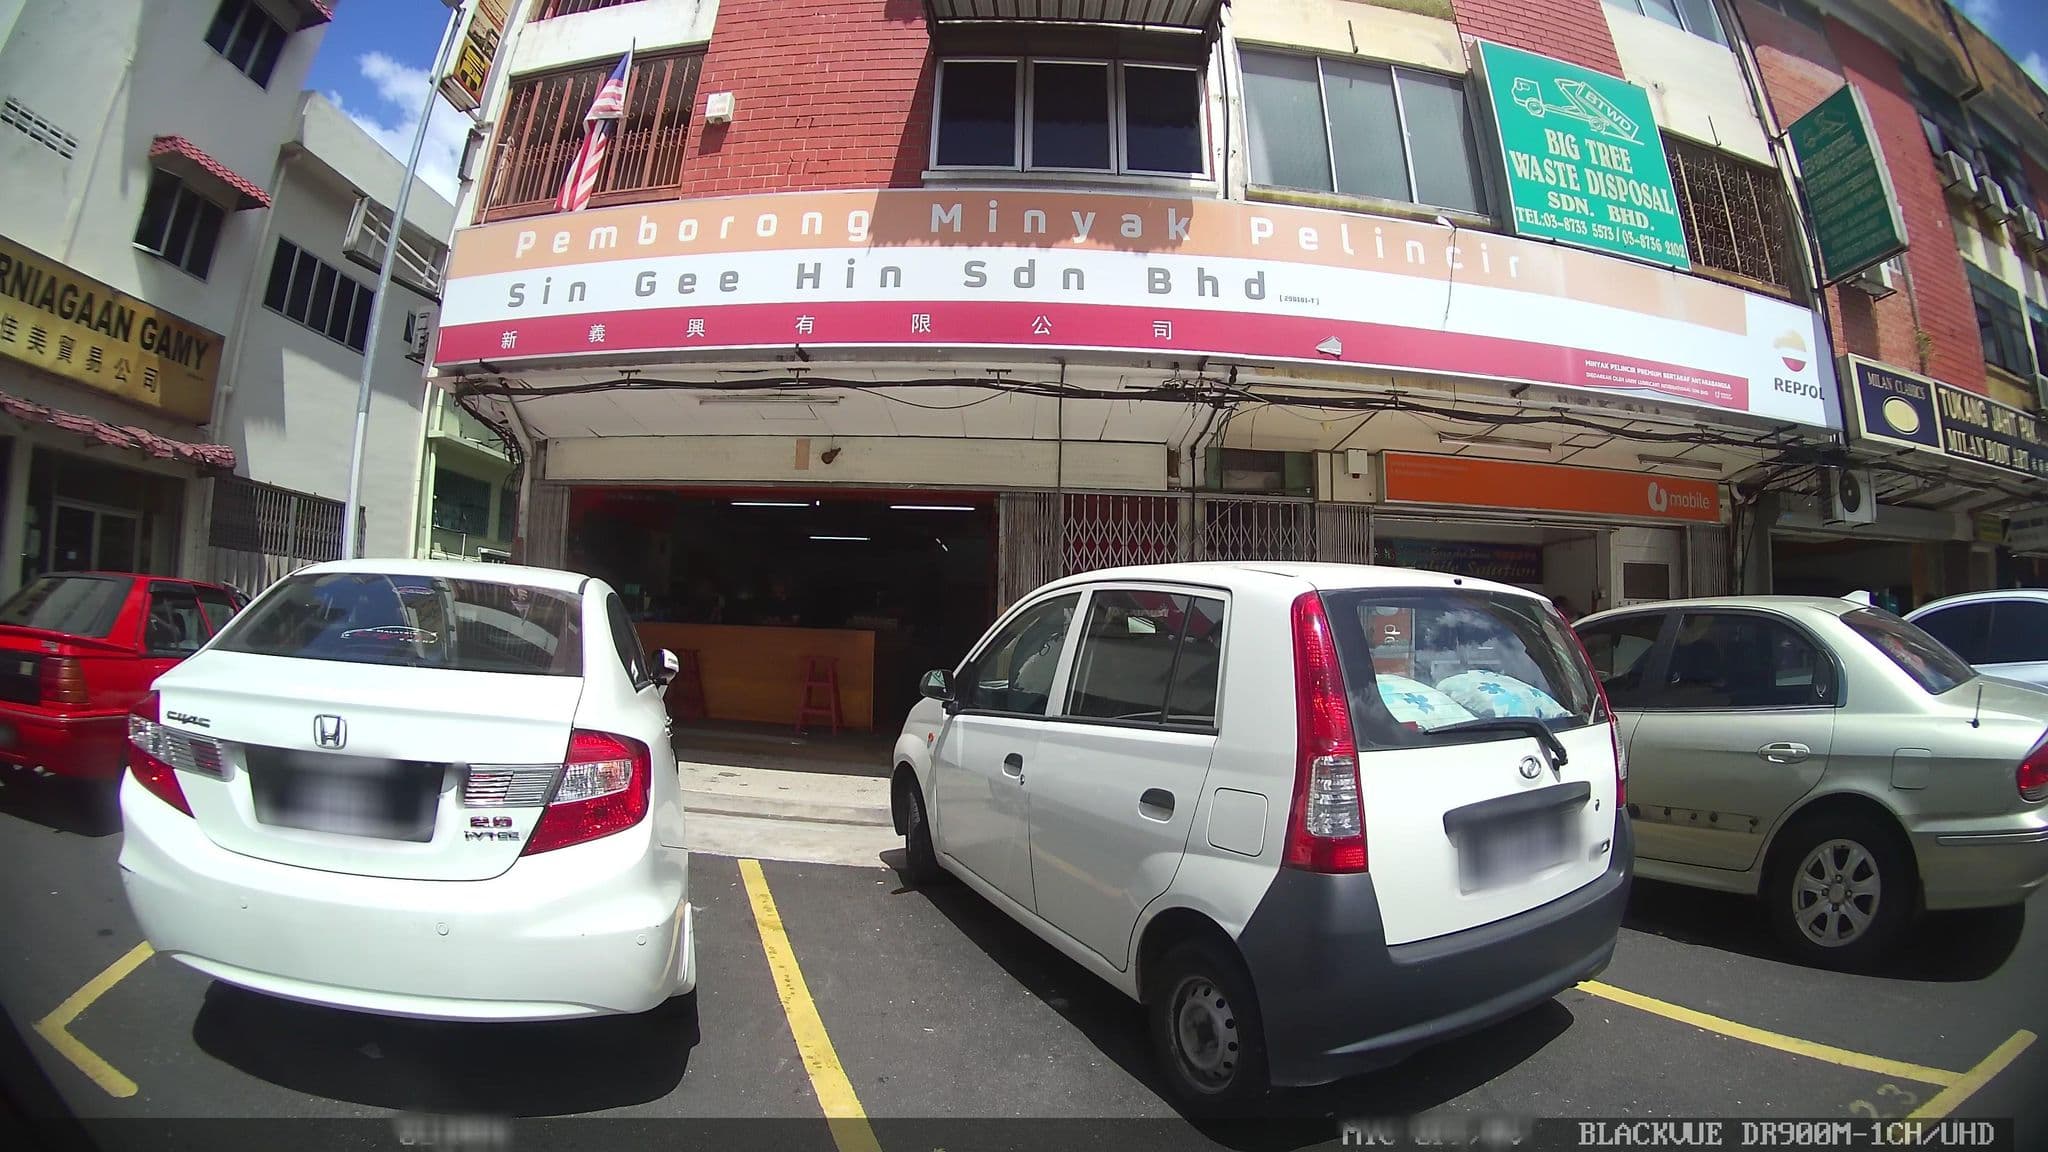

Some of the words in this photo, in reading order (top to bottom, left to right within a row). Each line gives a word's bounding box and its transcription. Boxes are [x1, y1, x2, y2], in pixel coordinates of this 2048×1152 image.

[1584, 91, 1633, 132] BTWD
[1544, 128, 1580, 161] BIG
[1584, 138, 1634, 174] TREE
[1509, 150, 1581, 192] WASTE
[1584, 168, 1675, 216] DISPOSAL
[1547, 192, 1596, 217] SDN.
[1607, 204, 1656, 231] BHD.
[515, 209, 869, 259] Pemborong
[930, 200, 1191, 244] Minyak
[1250, 215, 1520, 279] Pelincir
[507, 276, 587, 308] Sin
[635, 270, 740, 297] Gee
[796, 258, 902, 290] Hin
[963, 258, 1086, 291] Sdn
[1147, 266, 1266, 300] Bhd
[140, 317, 210, 371] GAMY
[500, 314, 1173, 350] 新義興有限公司
[1773, 377, 1825, 401] REPSOL
[1867, 371, 1893, 391] MILAN
[1938, 388, 1988, 428] TUKANG
[1669, 493, 1711, 512] mobile
